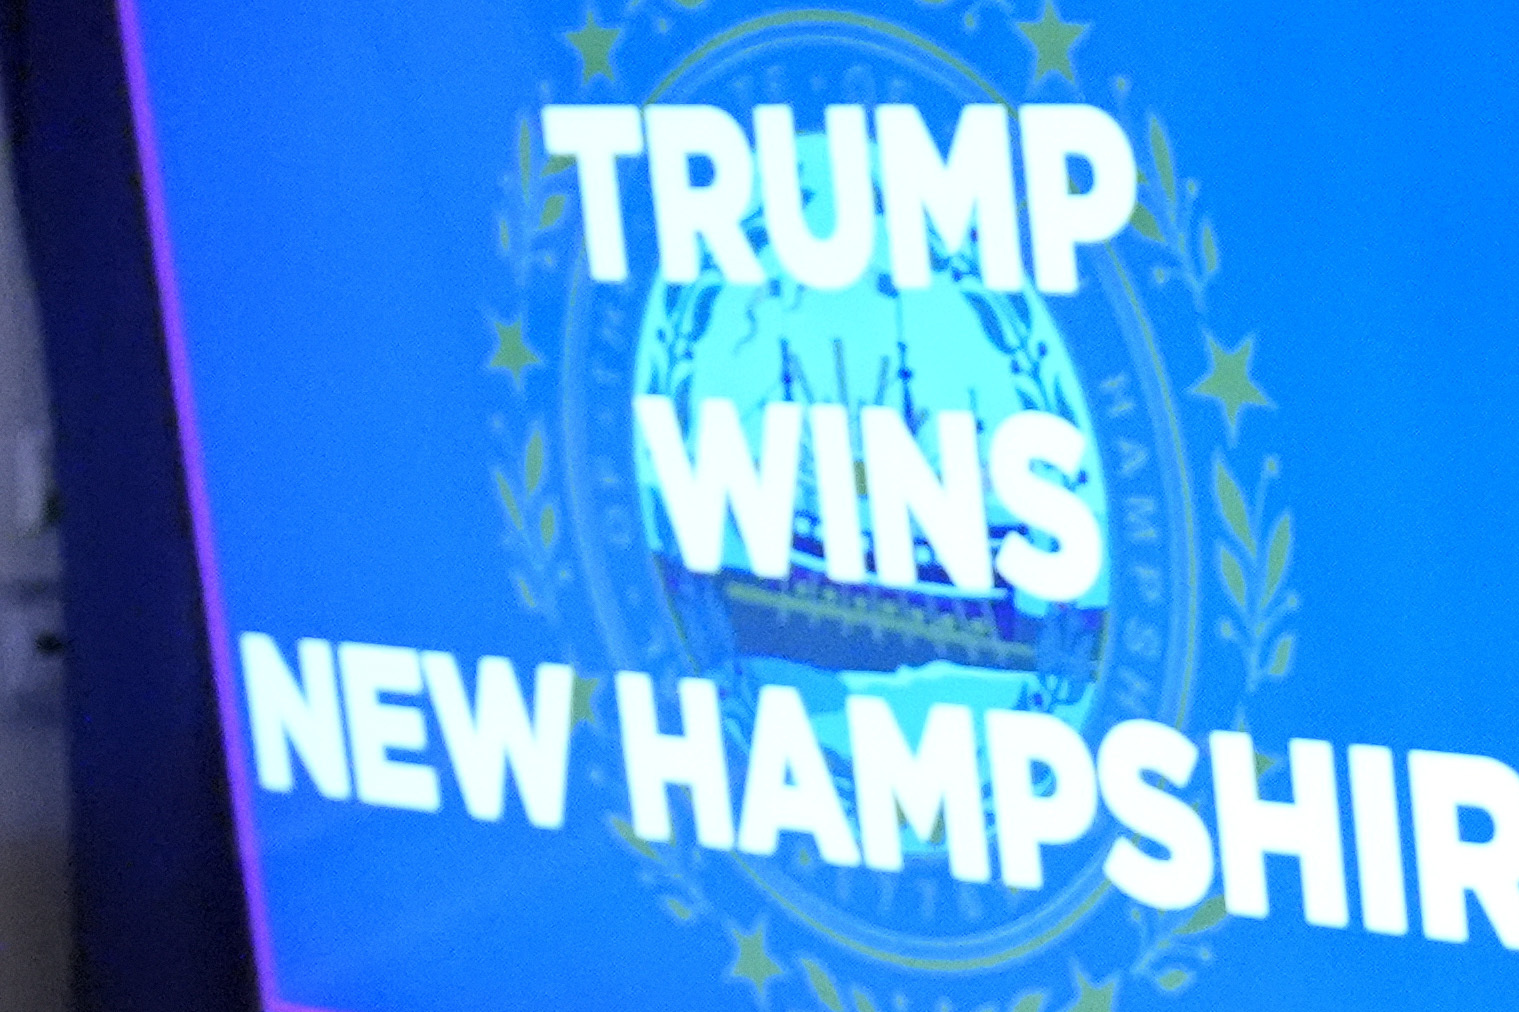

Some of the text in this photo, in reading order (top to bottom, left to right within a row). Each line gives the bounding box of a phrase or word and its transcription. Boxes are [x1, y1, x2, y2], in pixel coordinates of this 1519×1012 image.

[541, 103, 1138, 295] TRUMP
[632, 393, 1104, 602] WINS
[240, 632, 576, 829] NEW
